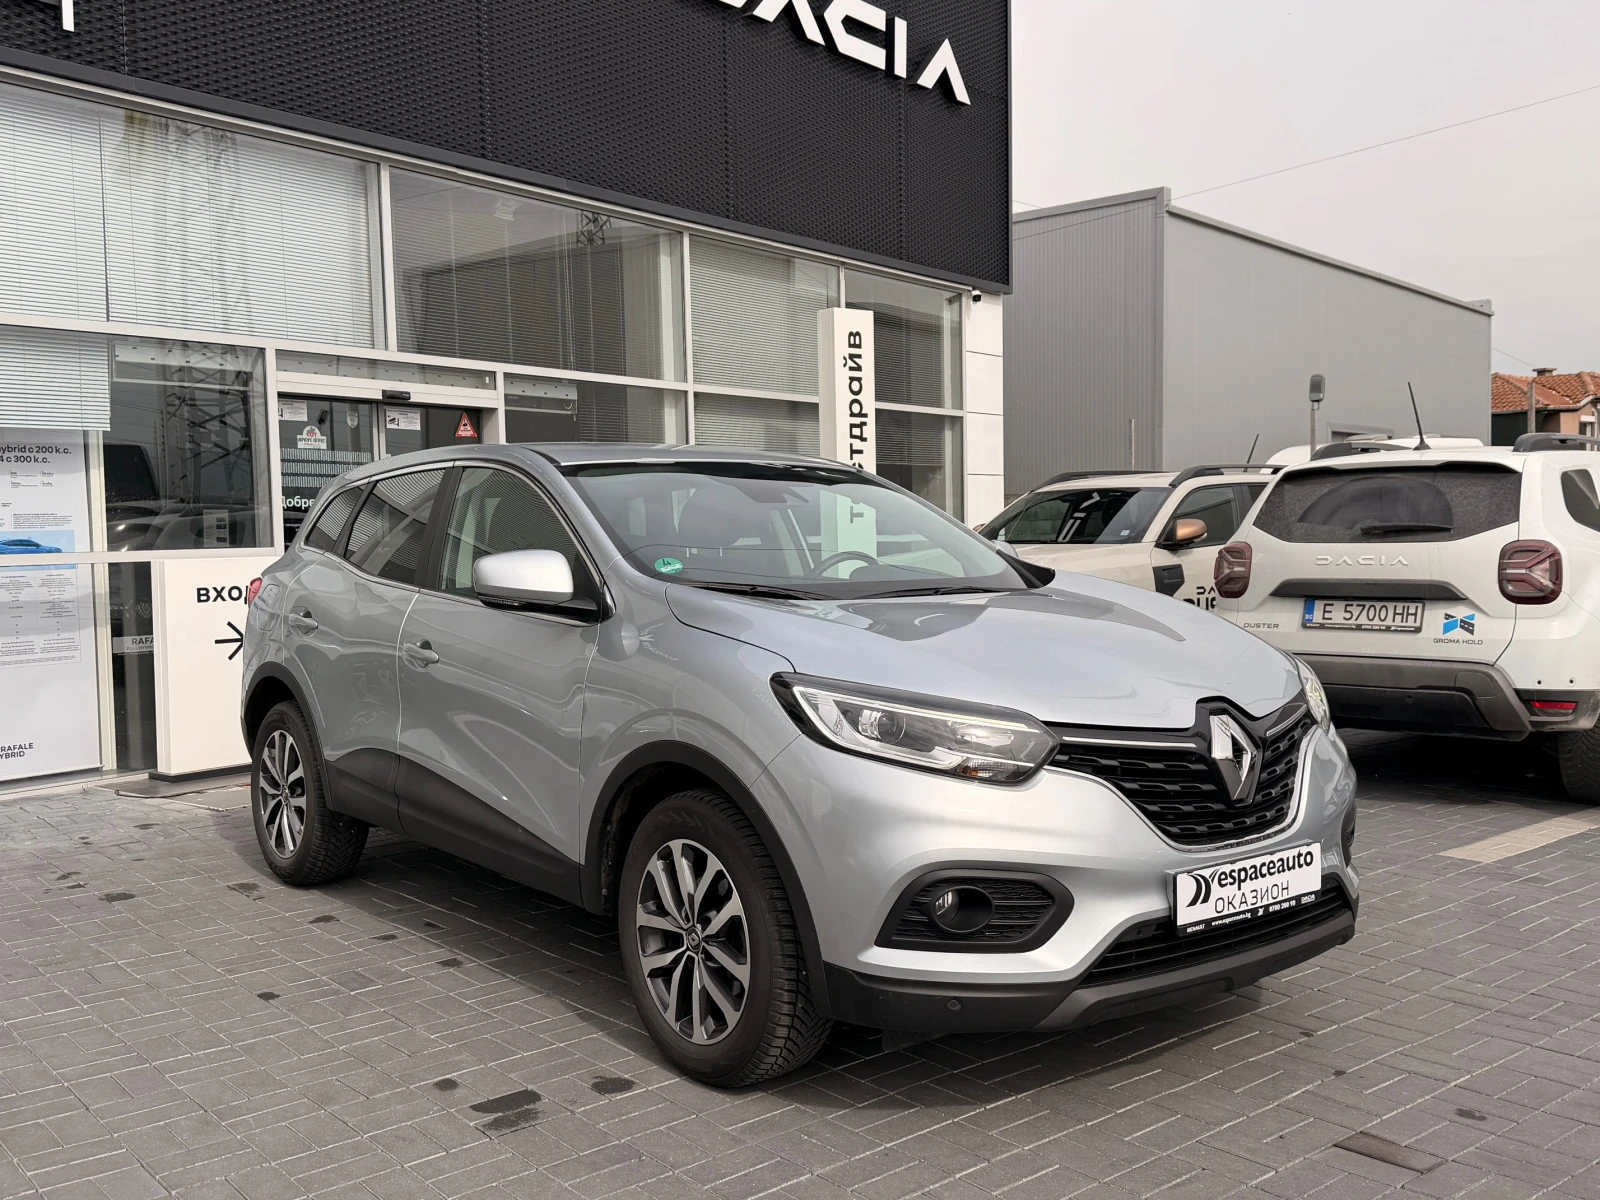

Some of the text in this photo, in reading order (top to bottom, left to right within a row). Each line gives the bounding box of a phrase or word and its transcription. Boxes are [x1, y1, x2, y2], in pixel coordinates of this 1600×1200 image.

[717, 0, 971, 105] ACIA
[0, 445, 27, 454] ybrid
[36, 446, 54, 454] 200
[14, 455, 32, 463] 300
[1315, 555, 1409, 566] DACIA
[1321, 603, 1419, 624] E 5700 HH
[0, 742, 34, 752] RAFALE
[1217, 849, 1314, 891] espaceauto
[1214, 880, 1290, 914] ОКАЗИОН
